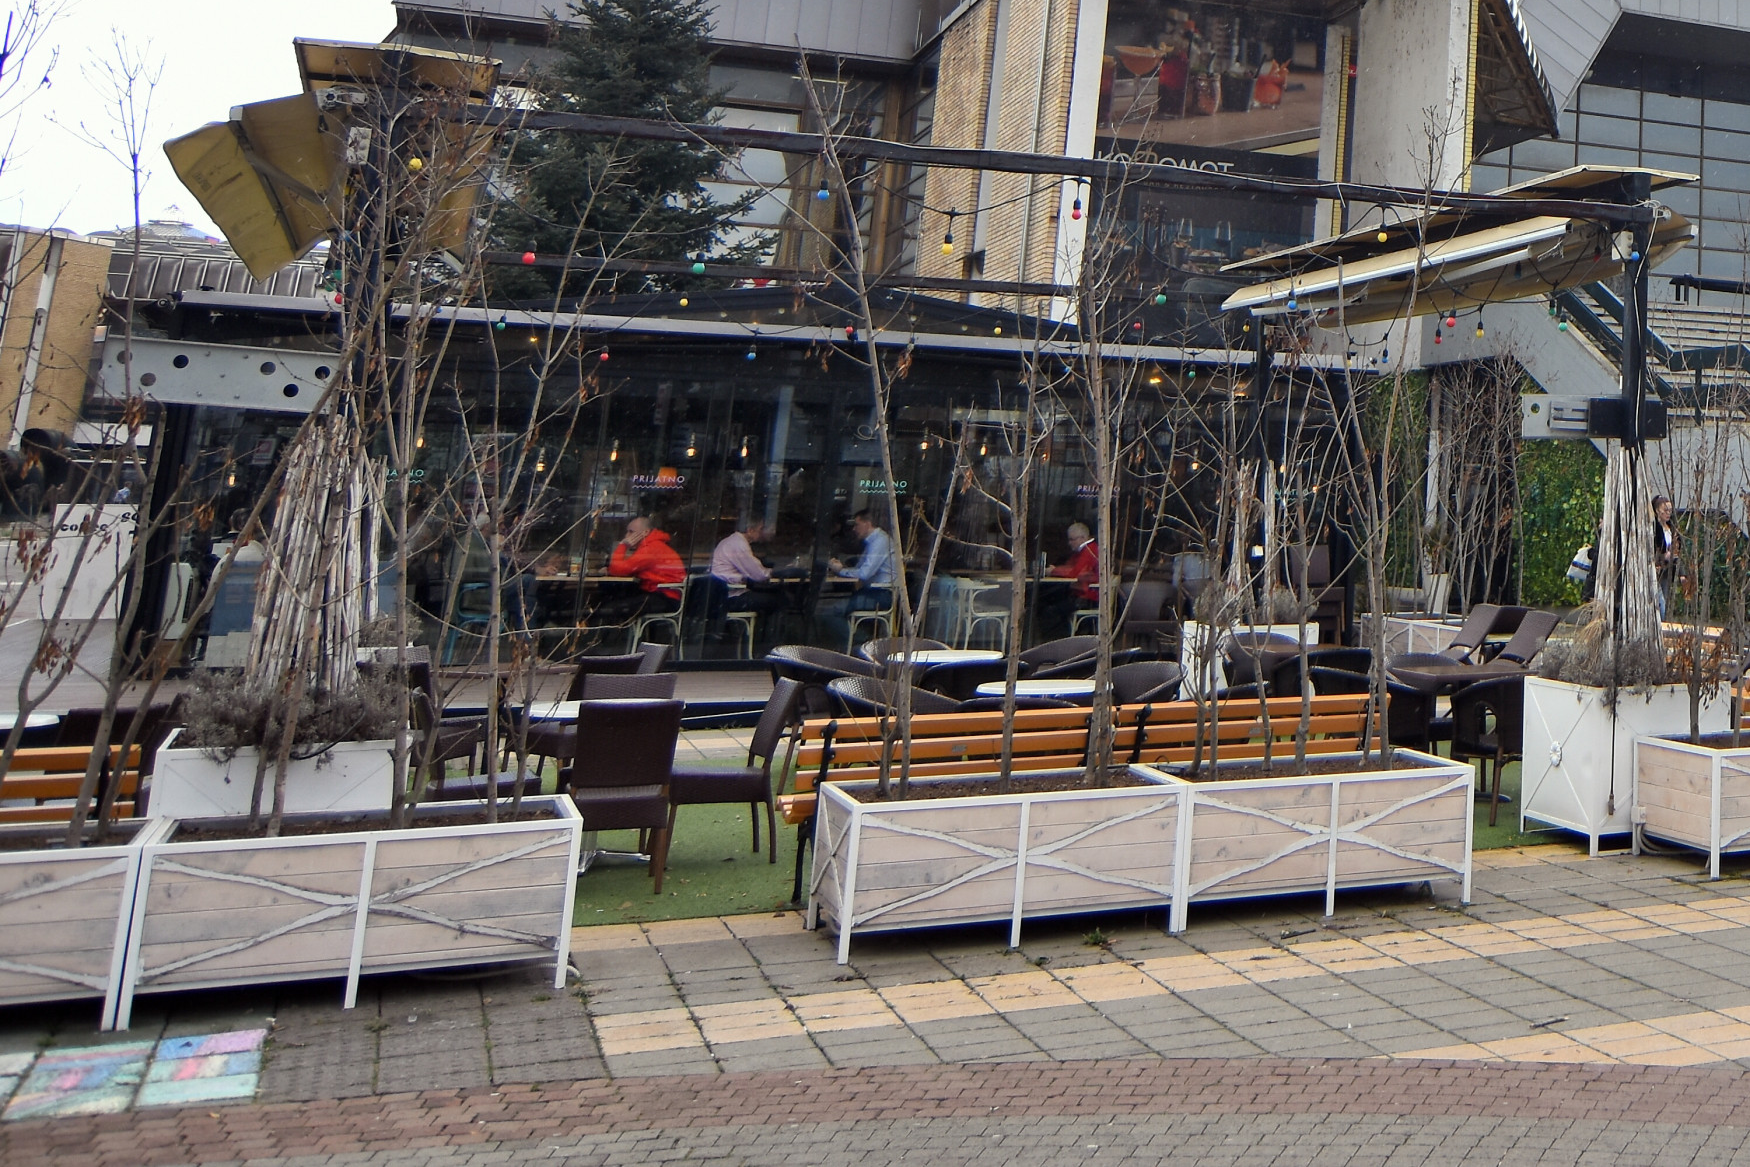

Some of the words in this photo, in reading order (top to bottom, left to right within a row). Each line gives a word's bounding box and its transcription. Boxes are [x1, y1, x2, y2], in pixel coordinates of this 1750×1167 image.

[632, 474, 685, 483] PRIJATNO
[859, 479, 908, 488] PRIJANO
[1077, 484, 1121, 492] PRIJAO
